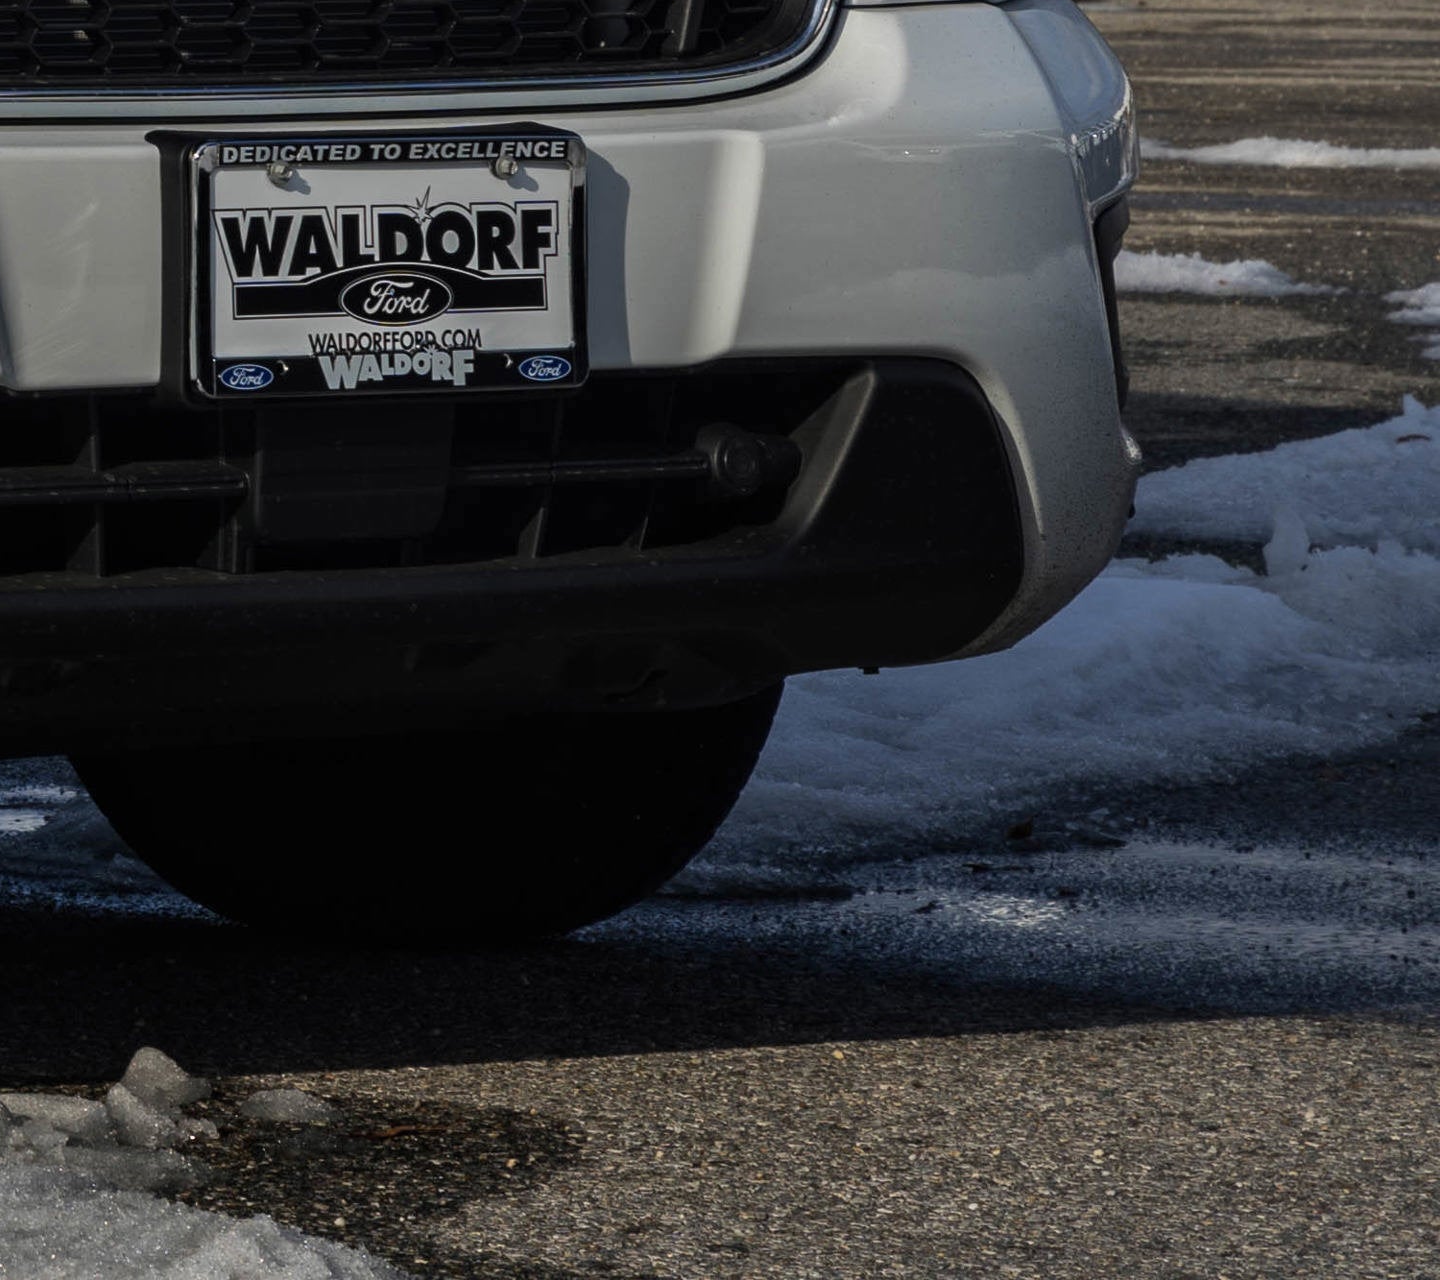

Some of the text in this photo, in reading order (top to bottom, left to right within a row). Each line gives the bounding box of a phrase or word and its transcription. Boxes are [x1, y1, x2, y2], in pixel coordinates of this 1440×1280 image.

[222, 141, 566, 163] DEDICATED TO EXCELLENCE
[219, 207, 555, 278] WALDORF
[363, 278, 432, 316] Ford
[308, 328, 483, 353] WALDORFFORDCOM
[229, 367, 265, 387] Ford
[317, 348, 476, 390] WALDORF
[526, 358, 563, 378] Ford
